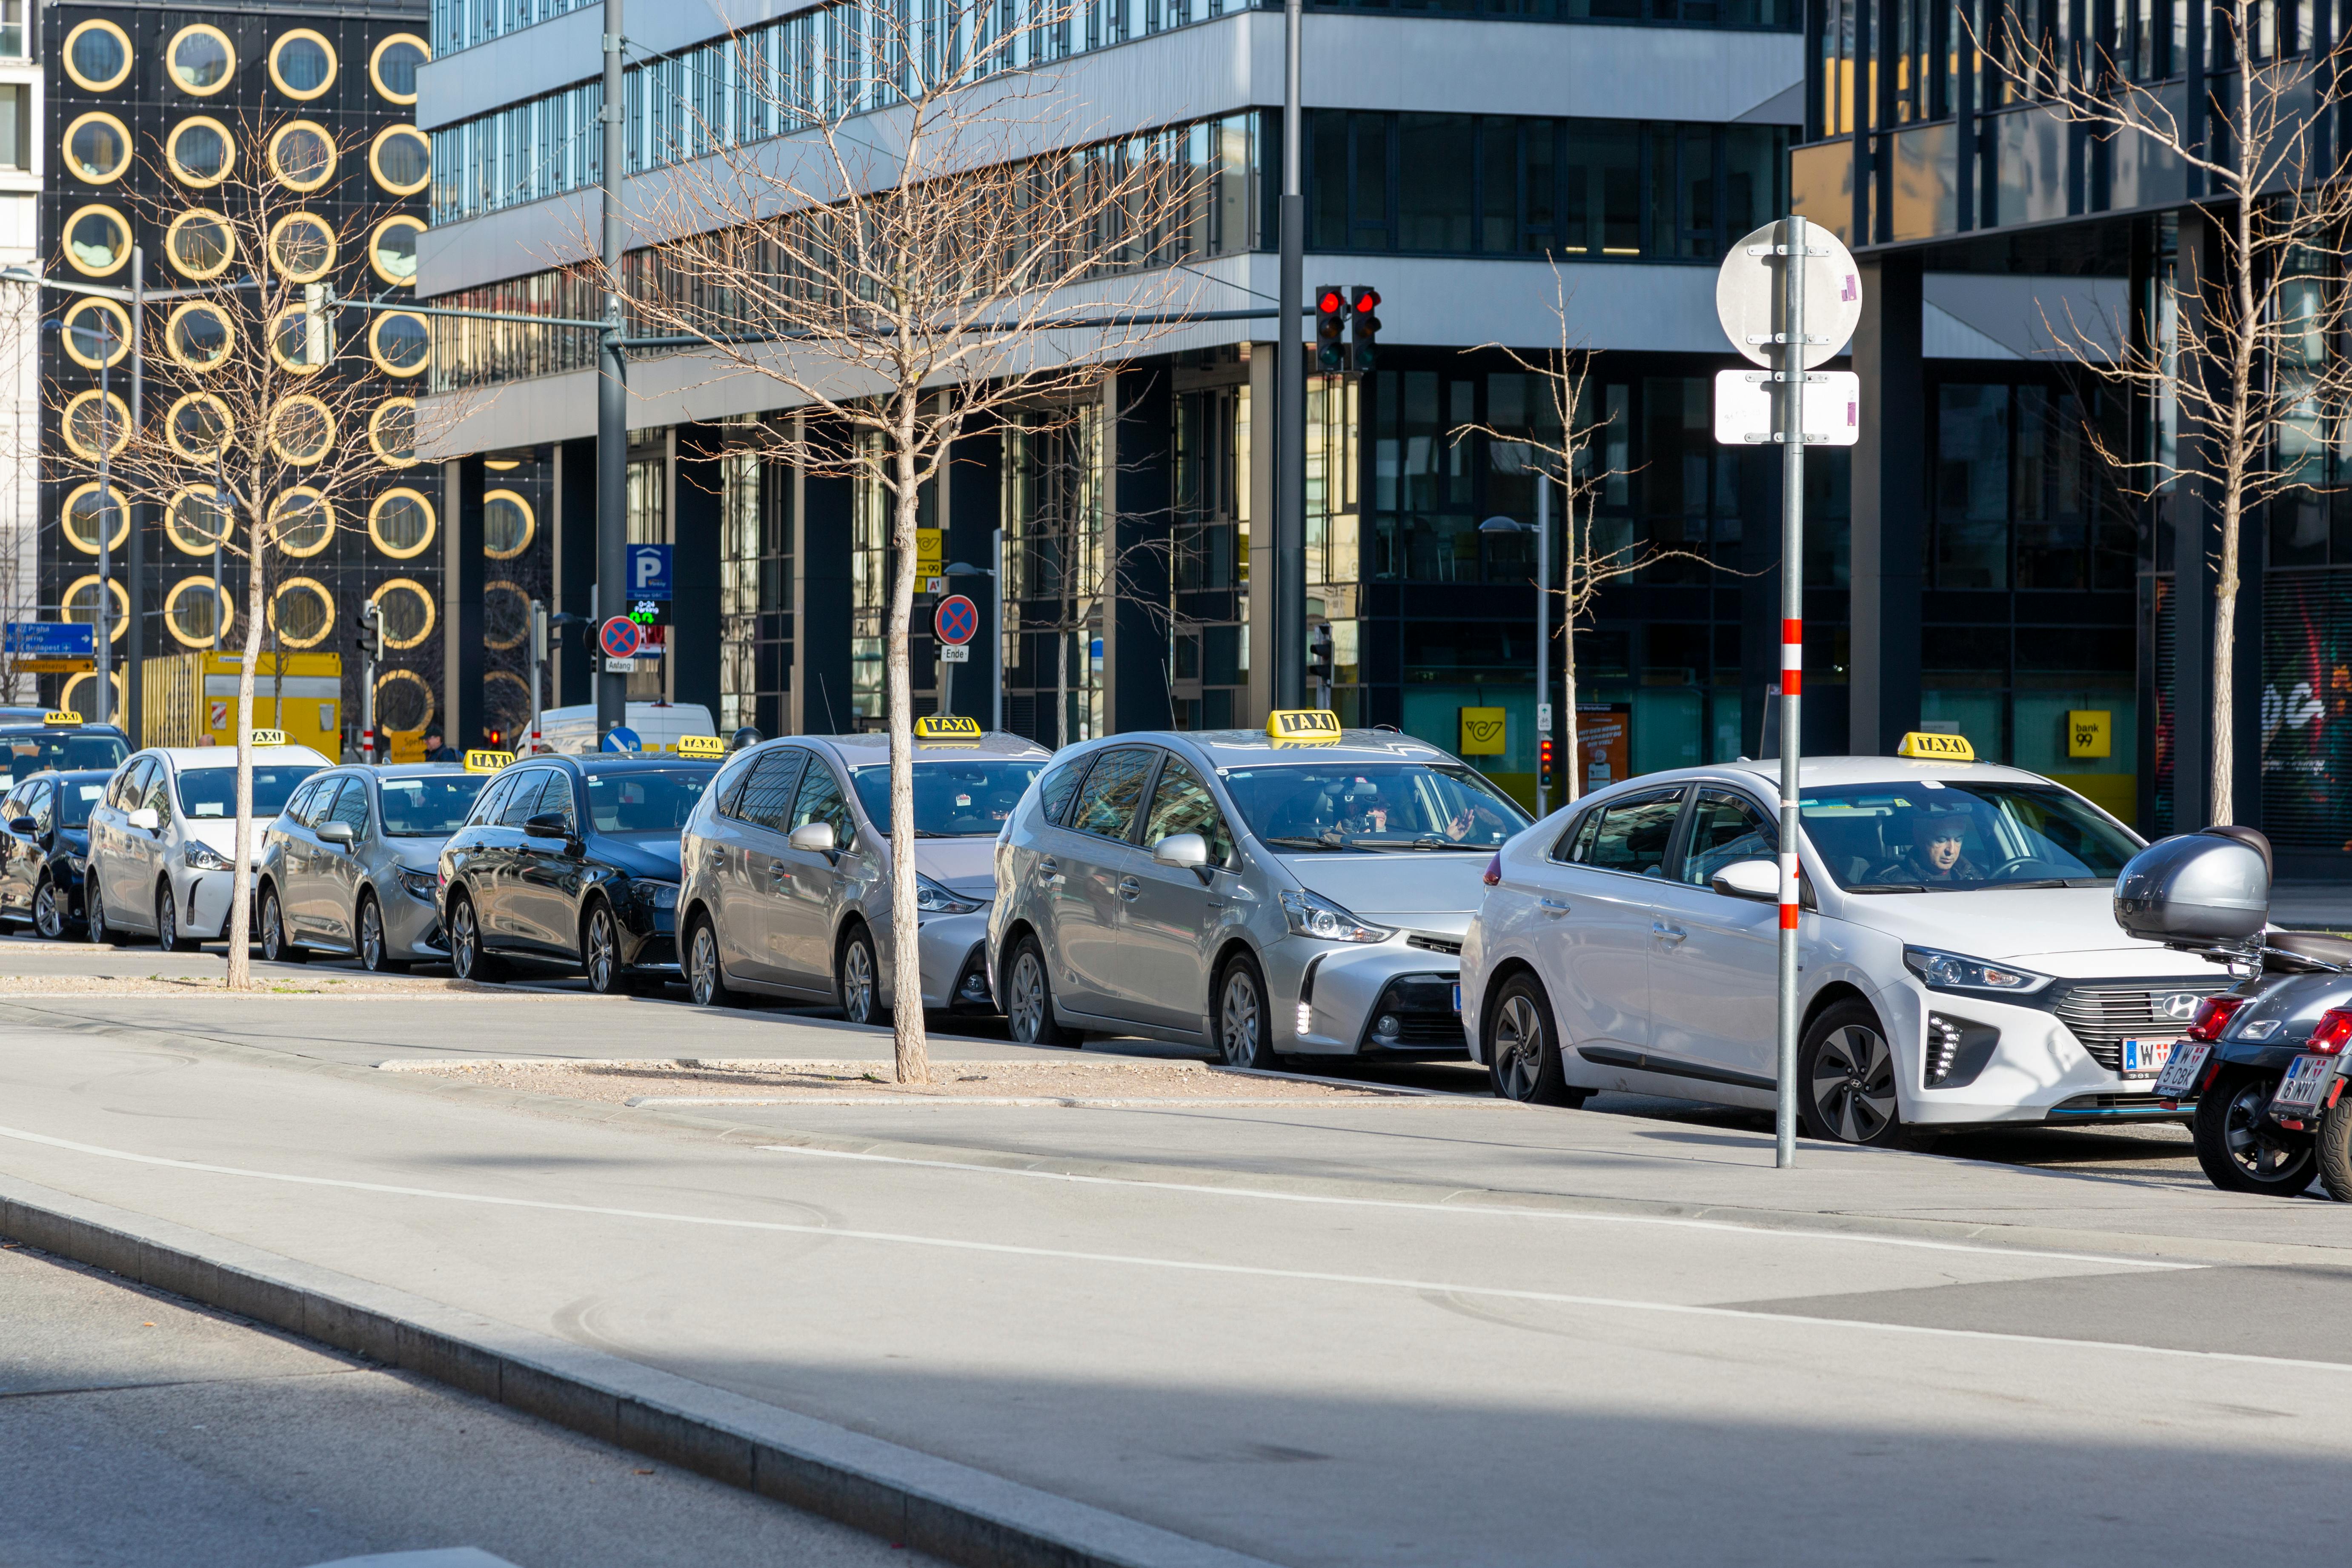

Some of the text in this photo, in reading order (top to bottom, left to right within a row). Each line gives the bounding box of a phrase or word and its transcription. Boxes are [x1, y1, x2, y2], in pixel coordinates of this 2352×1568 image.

[637, 557, 662, 588] P
[928, 564, 939, 573] 99
[634, 606, 659, 615] Parking
[947, 649, 964, 658] Ende
[609, 661, 631, 671] Anfang
[927, 719, 973, 731] TAXI
[1283, 714, 1334, 731] TAXI
[2076, 722, 2099, 732] bank
[685, 738, 717, 748] TAXI
[1918, 737, 1966, 753] TAXI
[2076, 733, 2093, 747] 99
[475, 754, 511, 767] TAXI
[2141, 1044, 2153, 1065] W
[2180, 1047, 2194, 1064] W
[2163, 1066, 2195, 1086] 5 CBK
[2301, 1060, 2315, 1079] W
[2284, 1080, 2296, 1099] 6
